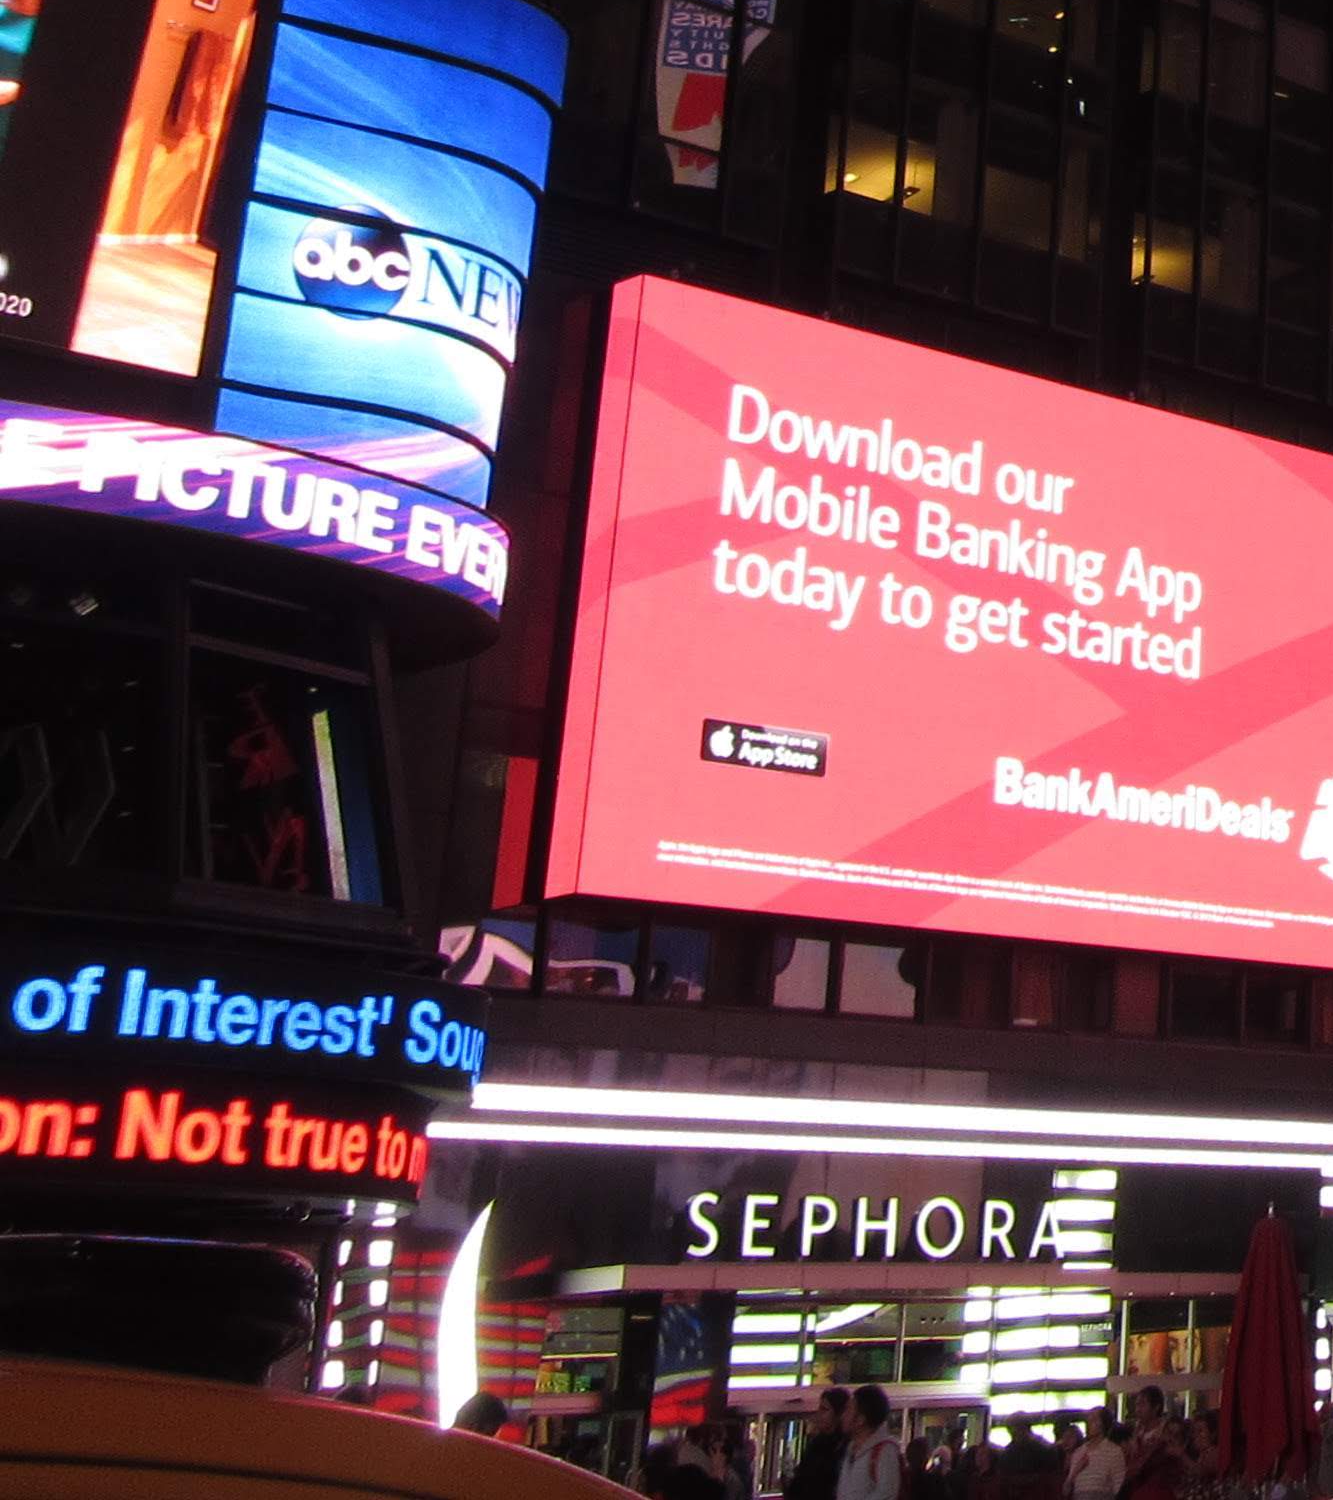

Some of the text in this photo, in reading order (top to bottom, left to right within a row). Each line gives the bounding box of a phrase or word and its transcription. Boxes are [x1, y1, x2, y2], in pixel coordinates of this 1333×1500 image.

[294, 231, 411, 292] abc
[79, 430, 399, 554] PICTURE
[726, 382, 1074, 516] Download our
[718, 456, 1202, 623] Mobile Banking App
[713, 537, 1201, 680] today to get started
[738, 742, 818, 771] App Store
[994, 756, 1291, 846] BankAmeriDeals
[11, 966, 105, 1035] of
[117, 968, 394, 1059] Interest'
[114, 1088, 250, 1165] Not
[263, 1104, 368, 1177] true
[375, 1115, 408, 1180] to
[686, 1191, 1068, 1261] SEPHORA
[1081, 1321, 1113, 1334] SEPHORA
